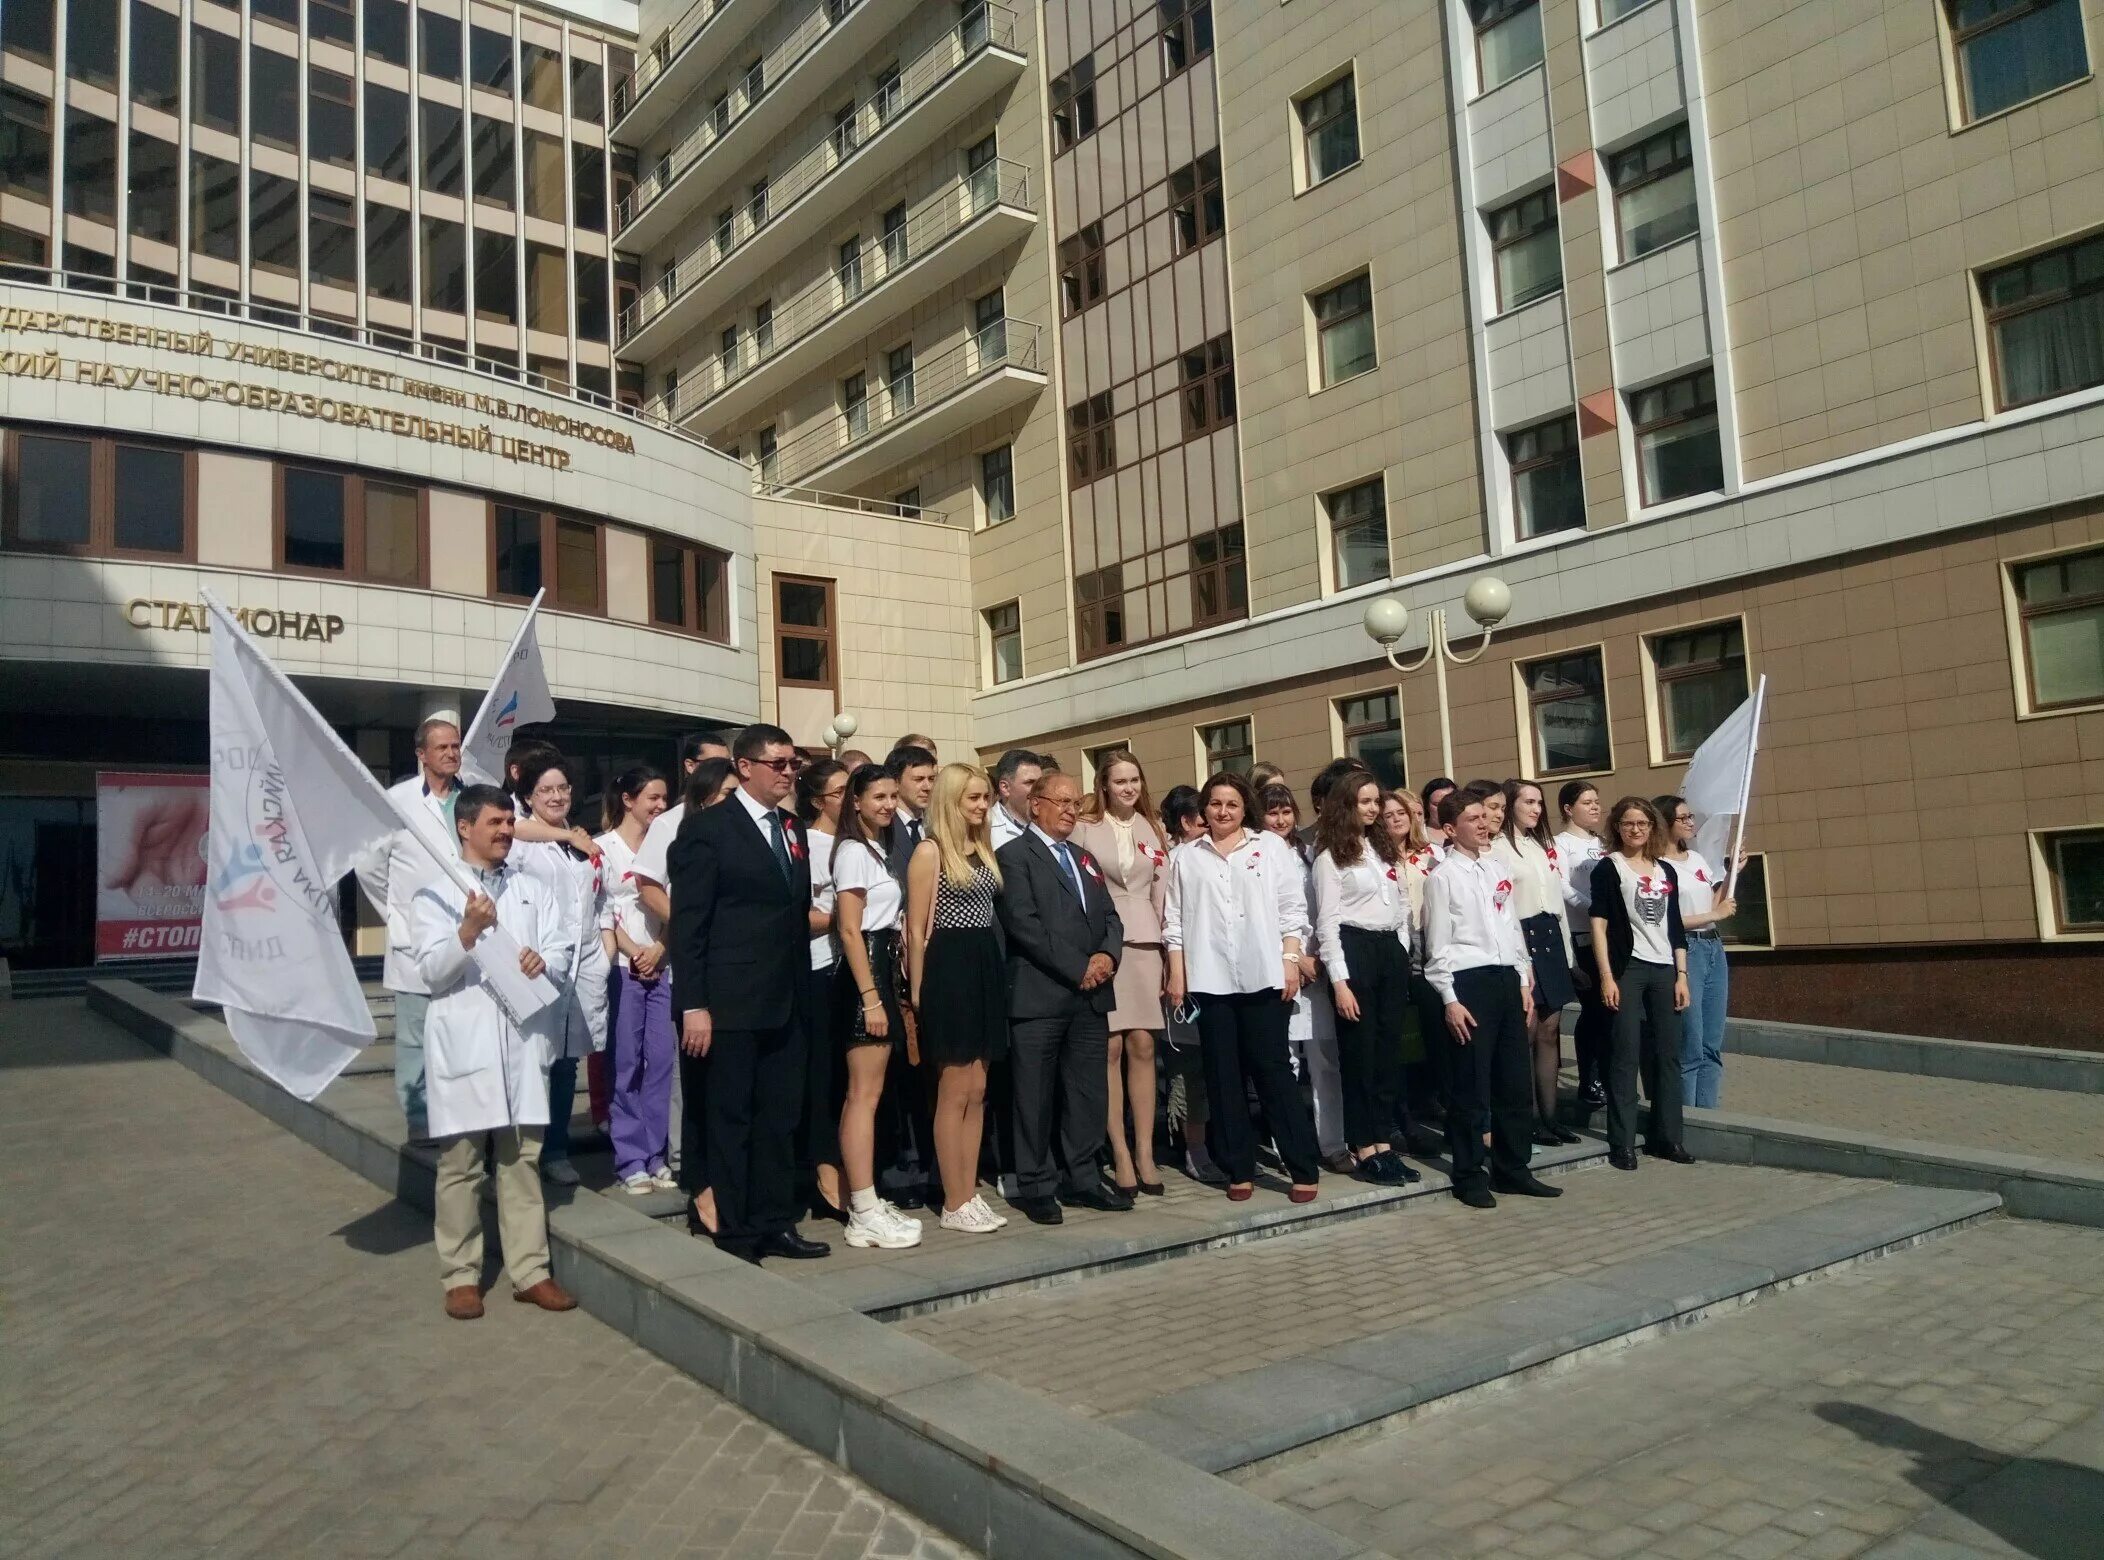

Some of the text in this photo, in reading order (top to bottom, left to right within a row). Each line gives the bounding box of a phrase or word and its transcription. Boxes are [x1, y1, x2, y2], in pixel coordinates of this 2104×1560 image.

[222, 337, 397, 392] УНИВЕРСИТЕТ
[75, 358, 493, 454] НАУЧНО-ОБРАЗОВАТЕЛЬНЫЙ
[501, 434, 571, 472] ЦЕНТР
